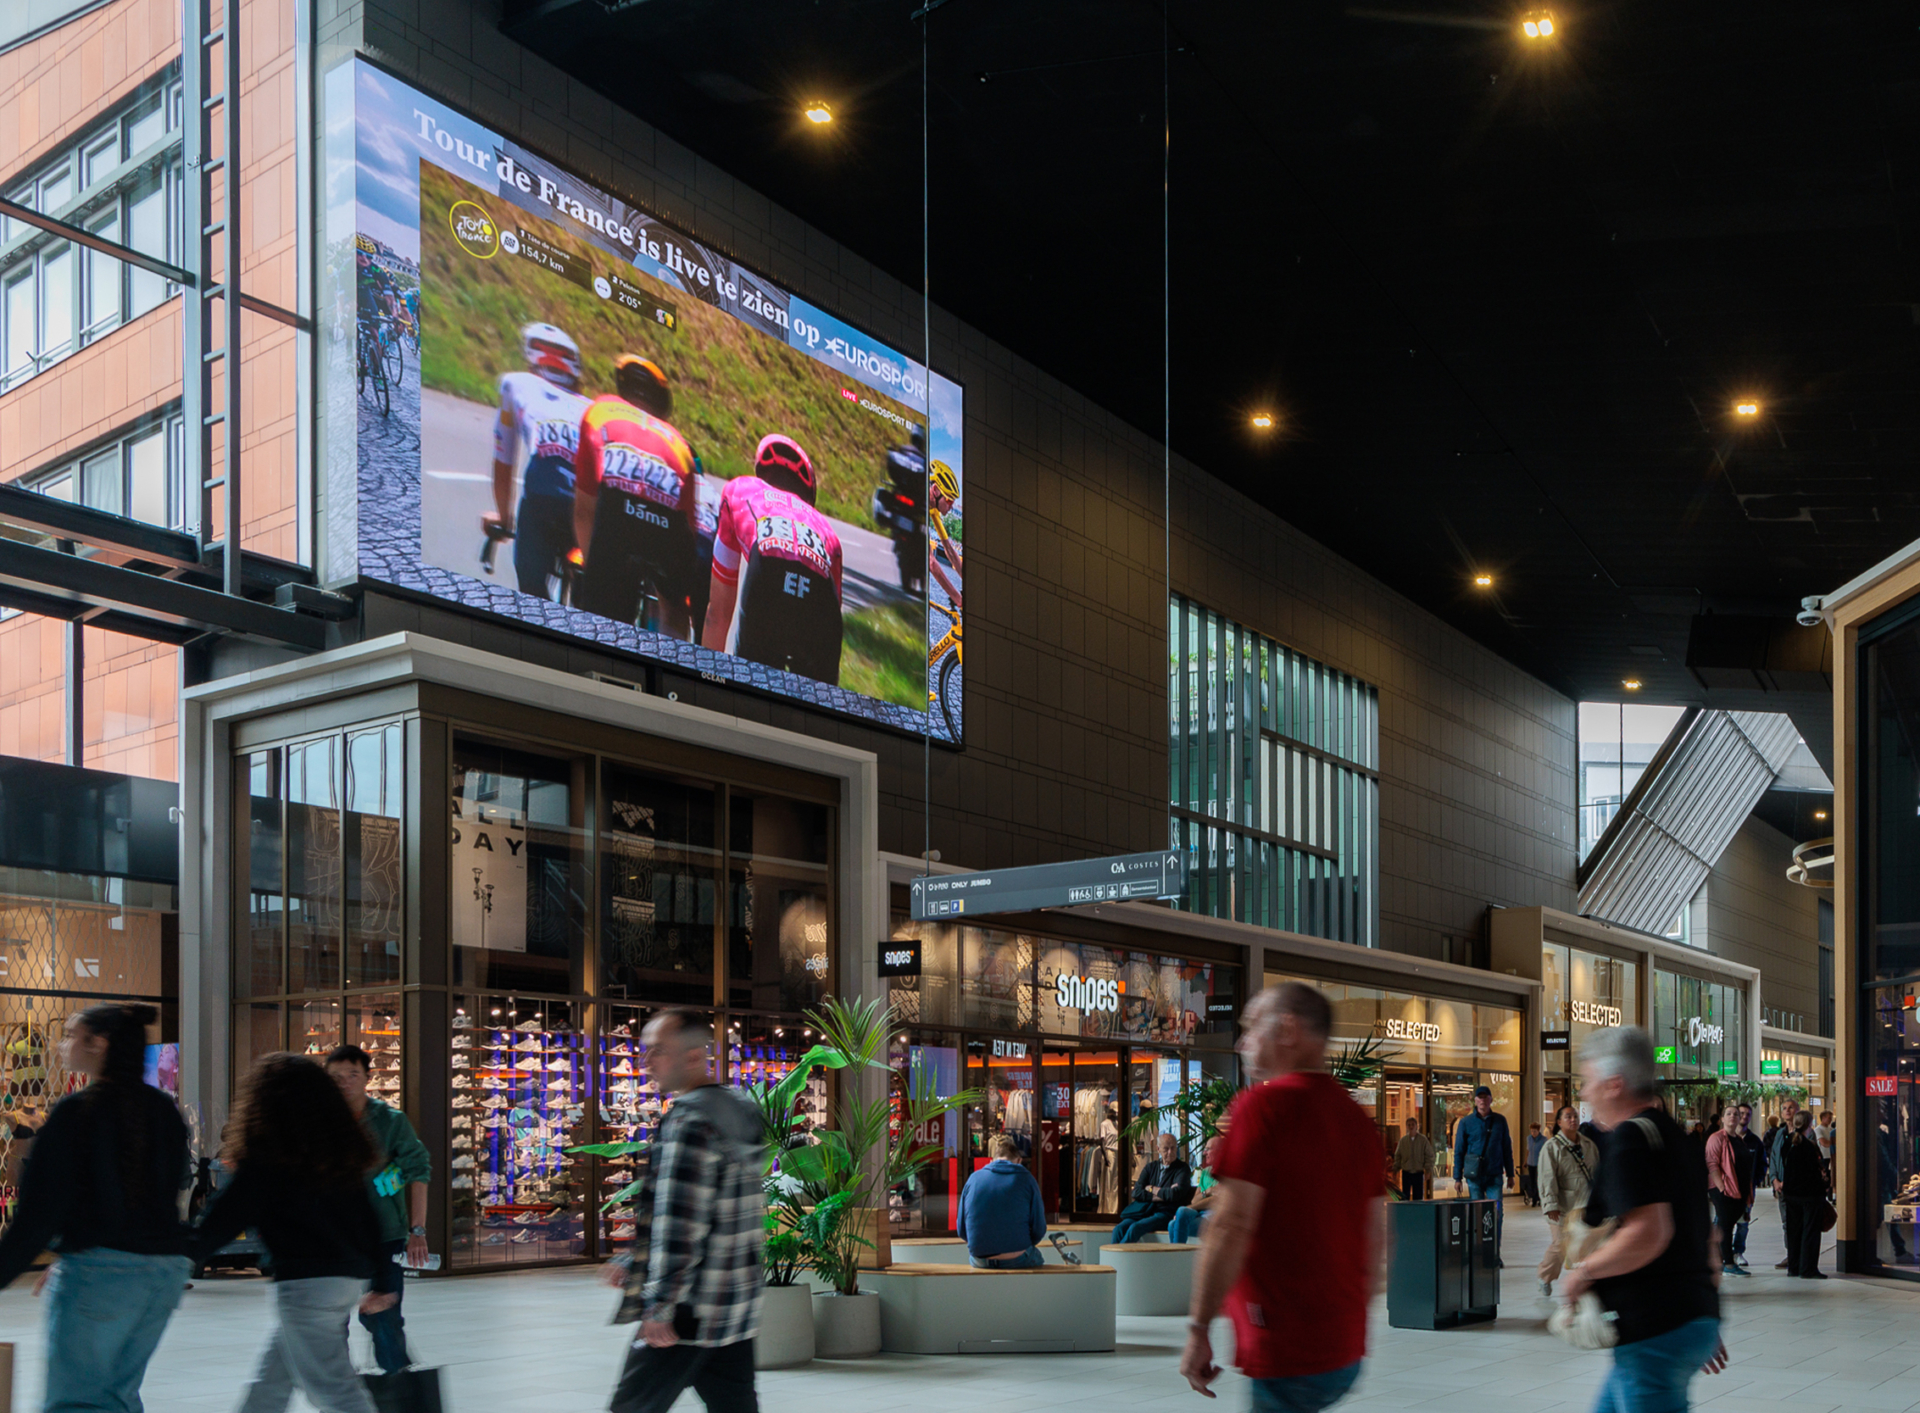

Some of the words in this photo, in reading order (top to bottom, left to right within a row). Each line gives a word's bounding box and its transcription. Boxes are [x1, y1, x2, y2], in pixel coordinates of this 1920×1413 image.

[413, 108, 491, 172] Tour
[496, 155, 532, 193] de
[537, 174, 634, 247] France
[638, 228, 660, 261] is
[664, 242, 710, 287] live
[715, 272, 737, 300] te
[742, 288, 790, 329] zien
[793, 318, 820, 350] op
[824, 337, 933, 401] EUROSPORT
[550, 257, 564, 273] km
[619, 279, 641, 295] Peloton
[842, 389, 858, 402] LIVE
[860, 399, 905, 426] EUROSPORT
[758, 538, 794, 552] VELUX
[798, 546, 830, 578] VELUX
[783, 571, 811, 599] EF
[701, 671, 727, 685] OCEAN
[1128, 861, 1159, 871] COSTES
[951, 881, 968, 889] ONLY
[885, 950, 912, 967] snipes
[1057, 973, 1118, 1017] snipes
[1571, 1000, 1622, 1028] SELECTED
[1386, 1019, 1440, 1042] SELECTED
[1869, 1079, 1894, 1093] SALE
